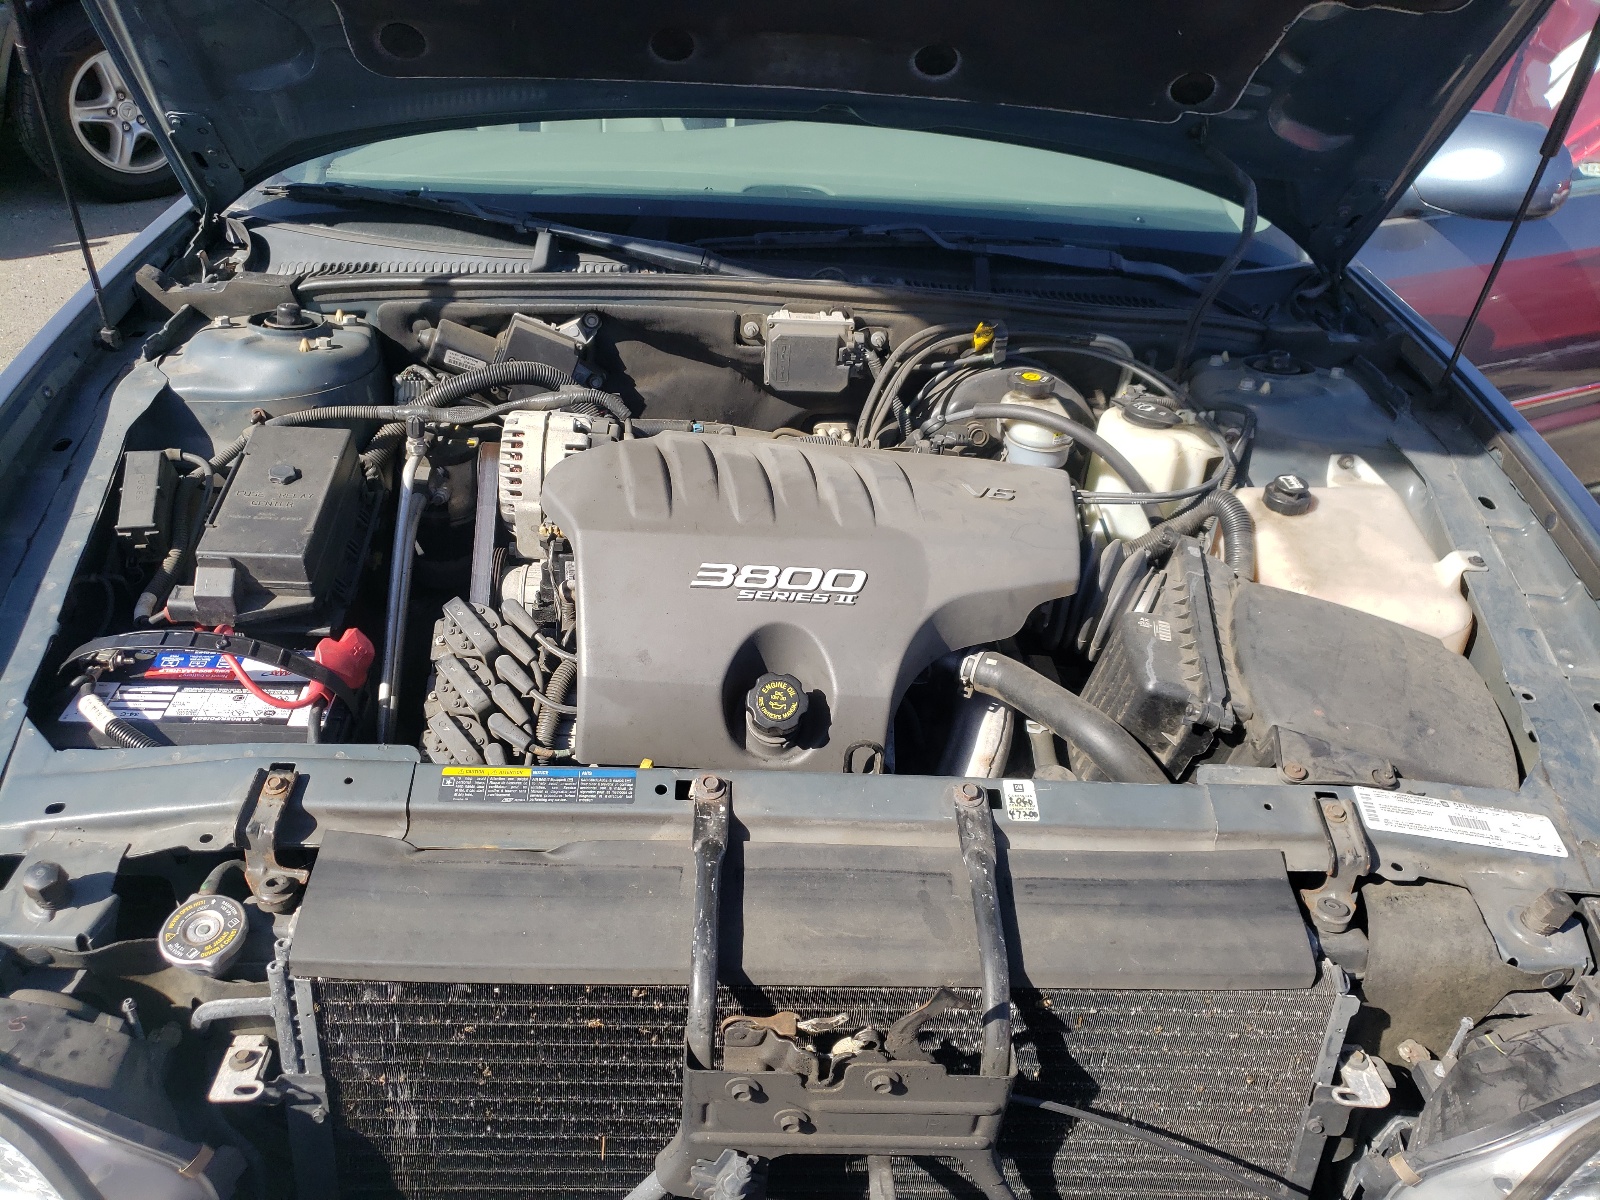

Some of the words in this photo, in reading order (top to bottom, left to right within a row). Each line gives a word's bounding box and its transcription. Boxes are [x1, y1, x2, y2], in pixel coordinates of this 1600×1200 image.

[961, 483, 1016, 501] V6
[690, 562, 868, 593] 3800
[736, 589, 832, 604] SERIES
[834, 593, 859, 606] II
[762, 682, 787, 694] ENGINE
[787, 686, 796, 698] OIL
[180, 904, 193, 914] OPEN
